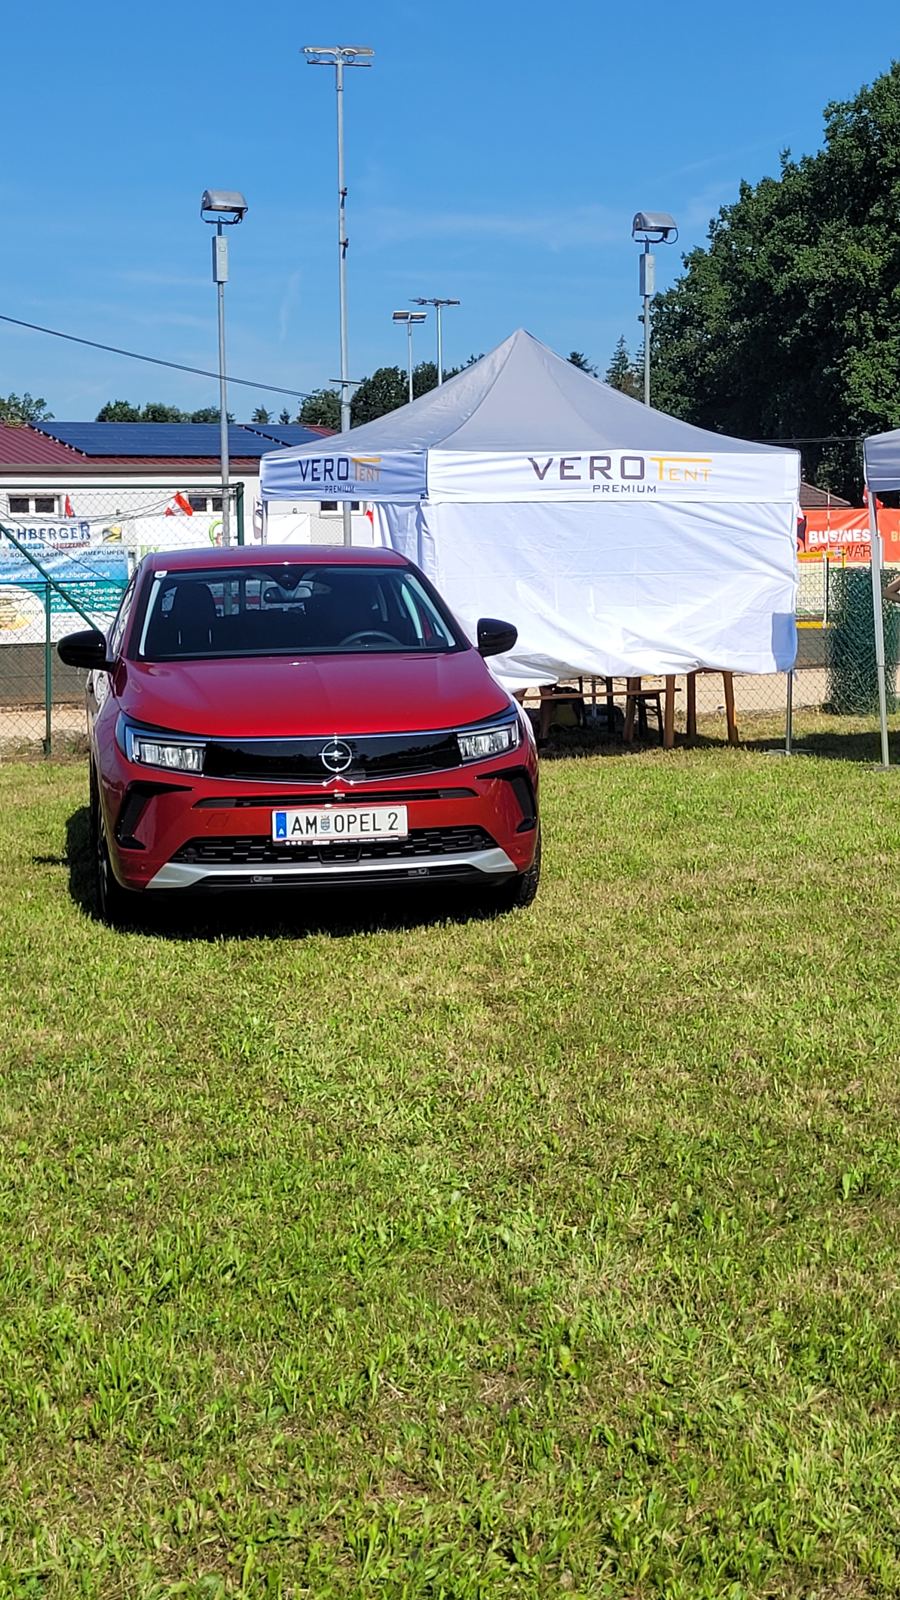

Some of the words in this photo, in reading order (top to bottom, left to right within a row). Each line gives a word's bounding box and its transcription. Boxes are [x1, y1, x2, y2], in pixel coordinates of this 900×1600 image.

[298, 458, 349, 481] VERO
[528, 456, 645, 480] VERO
[324, 485, 355, 493] PREMIUM
[592, 484, 657, 493] PREMIUM
[808, 529, 871, 544] BUSINES
[291, 816, 317, 835] AM
[334, 813, 382, 833] OPEL
[388, 812, 399, 831] 2
